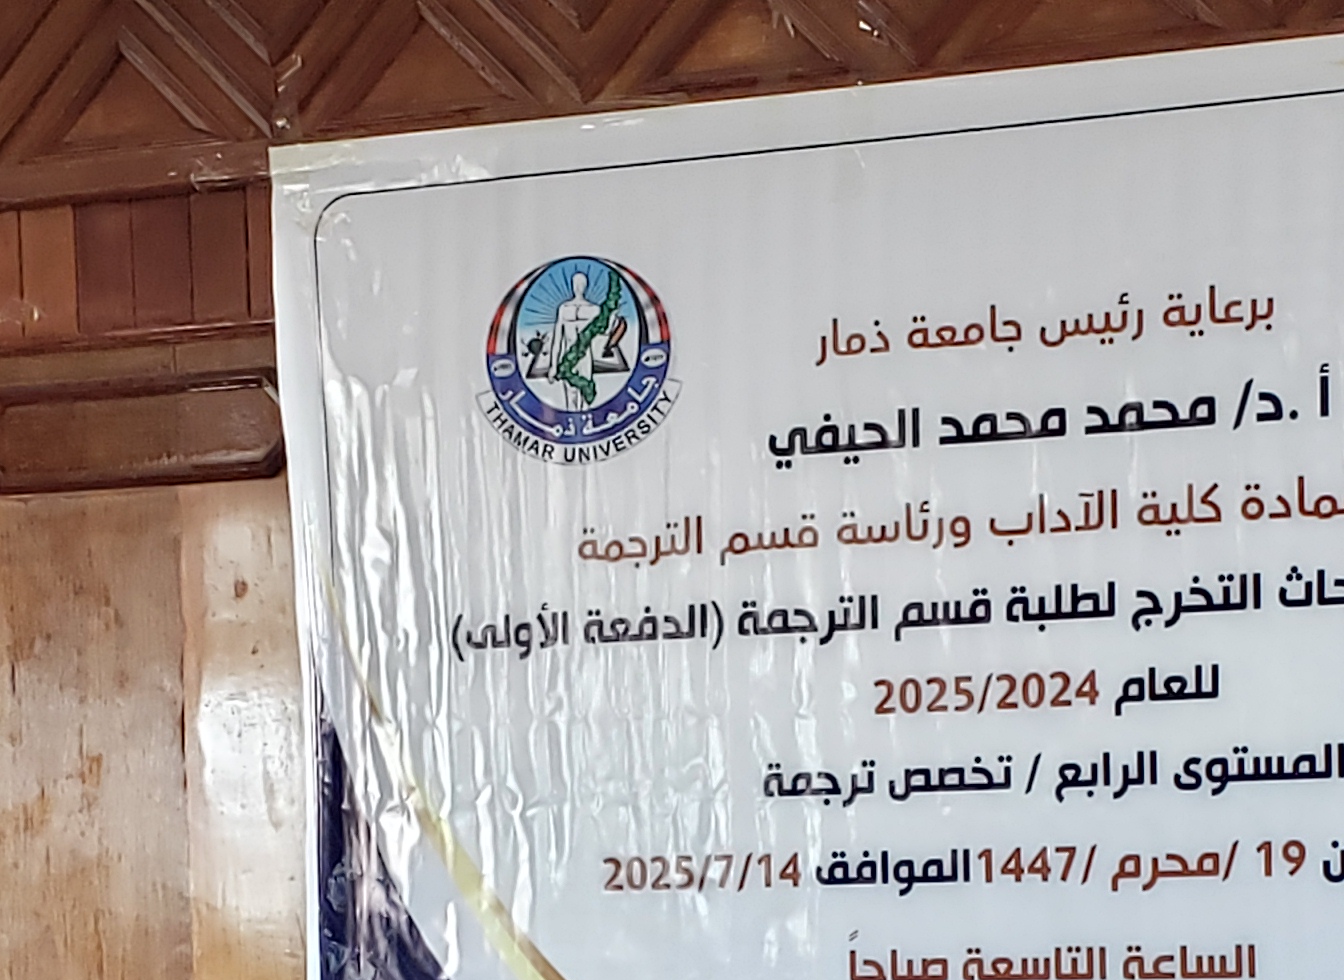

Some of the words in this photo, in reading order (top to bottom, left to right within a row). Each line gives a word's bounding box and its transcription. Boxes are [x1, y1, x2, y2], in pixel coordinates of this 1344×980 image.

[906, 303, 1023, 353] جامعة
[1039, 291, 1144, 348] رئيس
[1162, 284, 1274, 336] برعاية
[815, 317, 891, 367] ذمار
[485, 401, 555, 462] THAMAR
[563, 390, 672, 464] UNIVERSITY
[497, 389, 577, 438] ذمار
[582, 375, 661, 436] جامعة
[938, 407, 1067, 446] محمد
[1084, 395, 1217, 436] محمد
[768, 406, 921, 470] الحيفي
[836, 500, 972, 550] ورئاسة
[988, 488, 1118, 545] الآداب
[1136, 482, 1222, 537] كلية
[577, 514, 703, 569] الترجمة
[719, 513, 819, 567] قسم
[583, 600, 725, 651] (الدفعة
[737, 593, 879, 646] الترجمة
[894, 587, 992, 637] قسم
[1005, 580, 1116, 633] لطلبة
[1130, 572, 1262, 633] التخرج
[873, 668, 1100, 715] 2025/2024
[1114, 663, 1220, 717] للعام
[762, 759, 876, 809] ترجمة
[888, 754, 1014, 802] تخصص
[1054, 749, 1158, 804] الرابع
[602, 851, 802, 893] 2025/7/14
[1255, 839, 1307, 878] 19
[1122, 943, 1257, 980] الساعة
